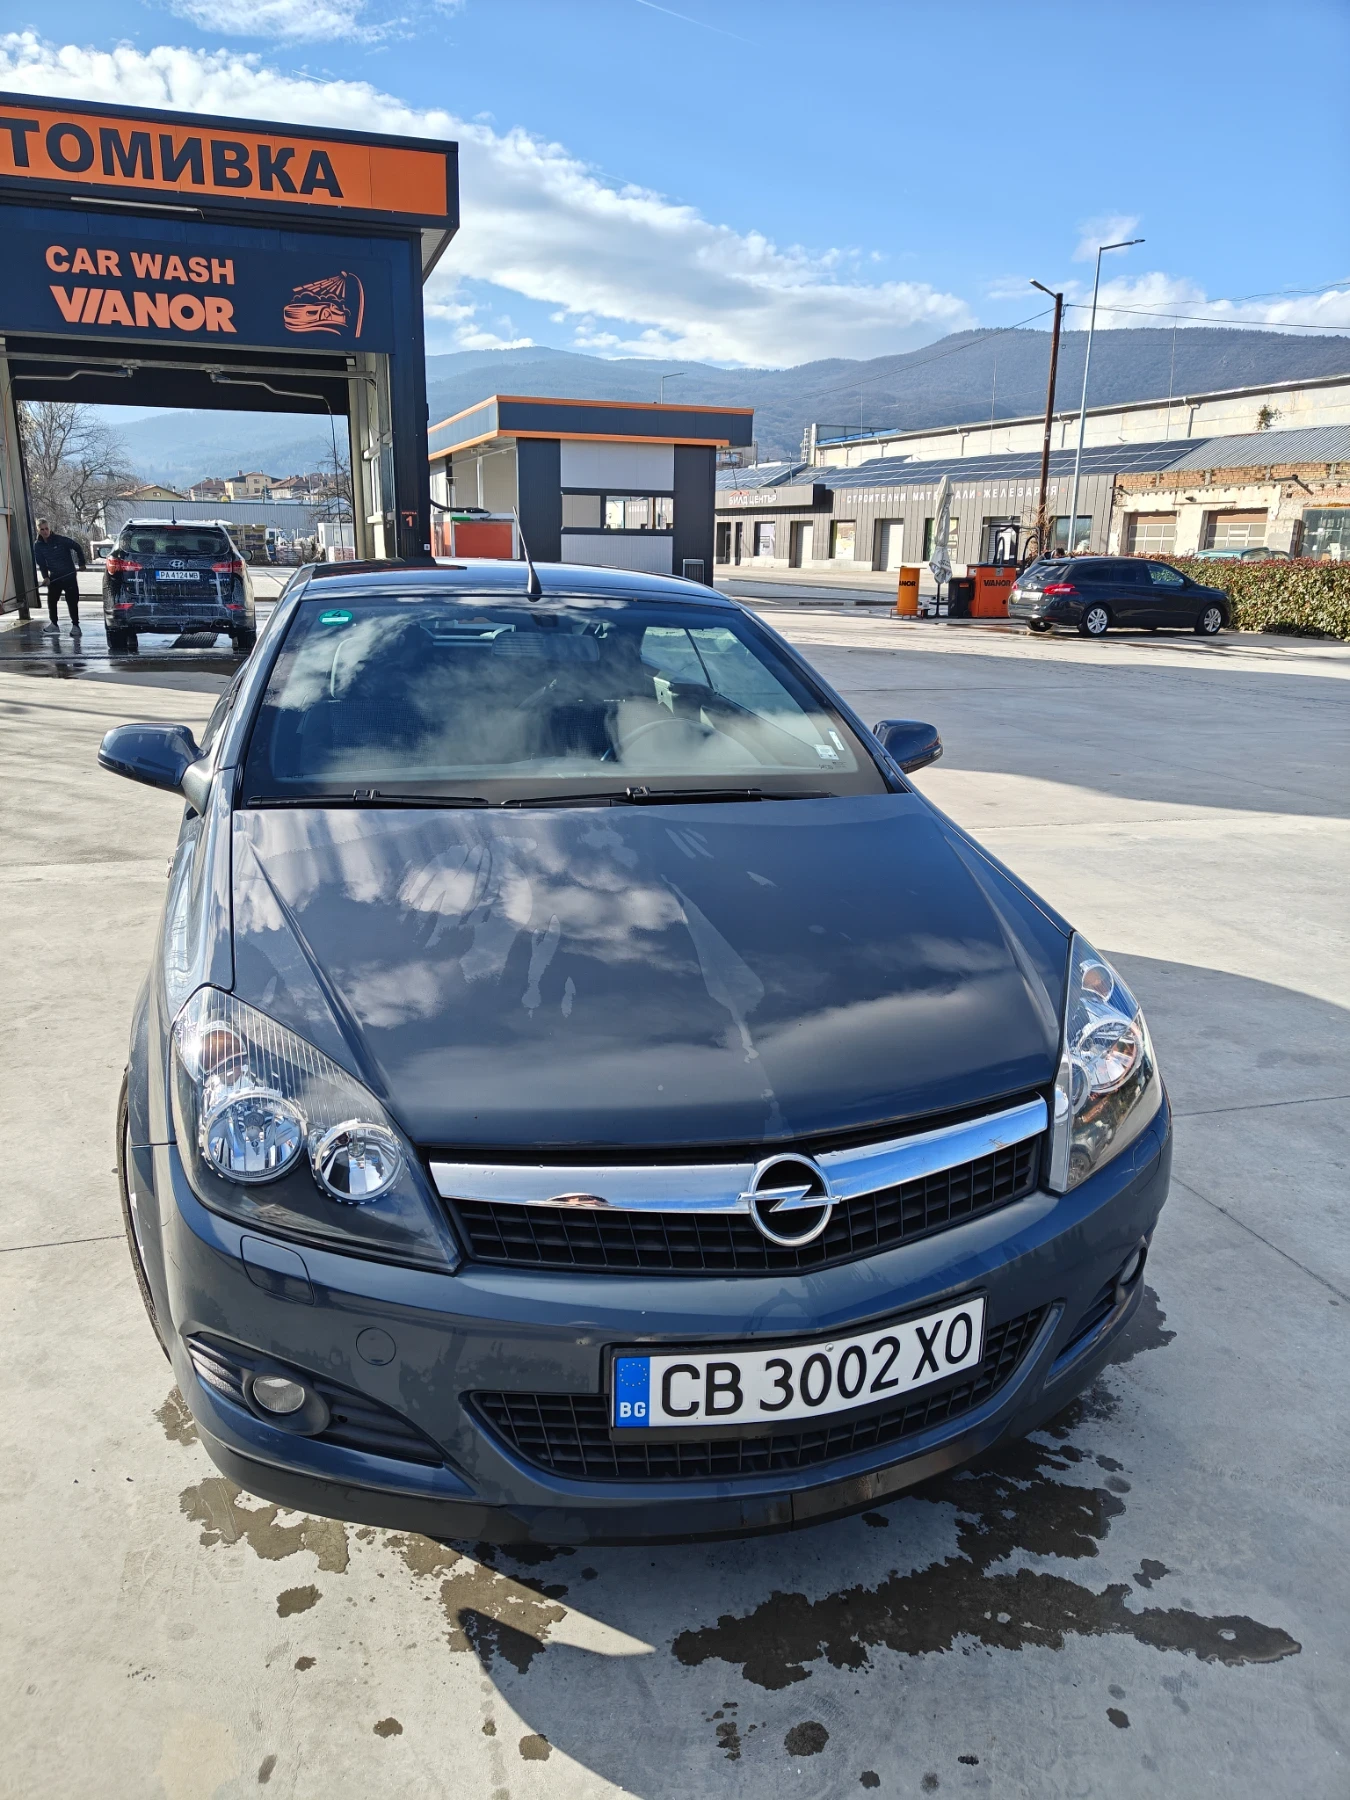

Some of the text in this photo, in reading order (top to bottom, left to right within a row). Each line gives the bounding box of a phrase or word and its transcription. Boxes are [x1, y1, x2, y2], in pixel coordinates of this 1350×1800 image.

[45, 245, 235, 285] CAR WASH
[49, 285, 237, 333] VIANOR
[846, 492, 907, 503] СТРОИТЕЛНИ
[405, 516, 413, 527] 1
[661, 1311, 973, 1418] CB 3002 XO
[619, 1401, 646, 1418] BG
